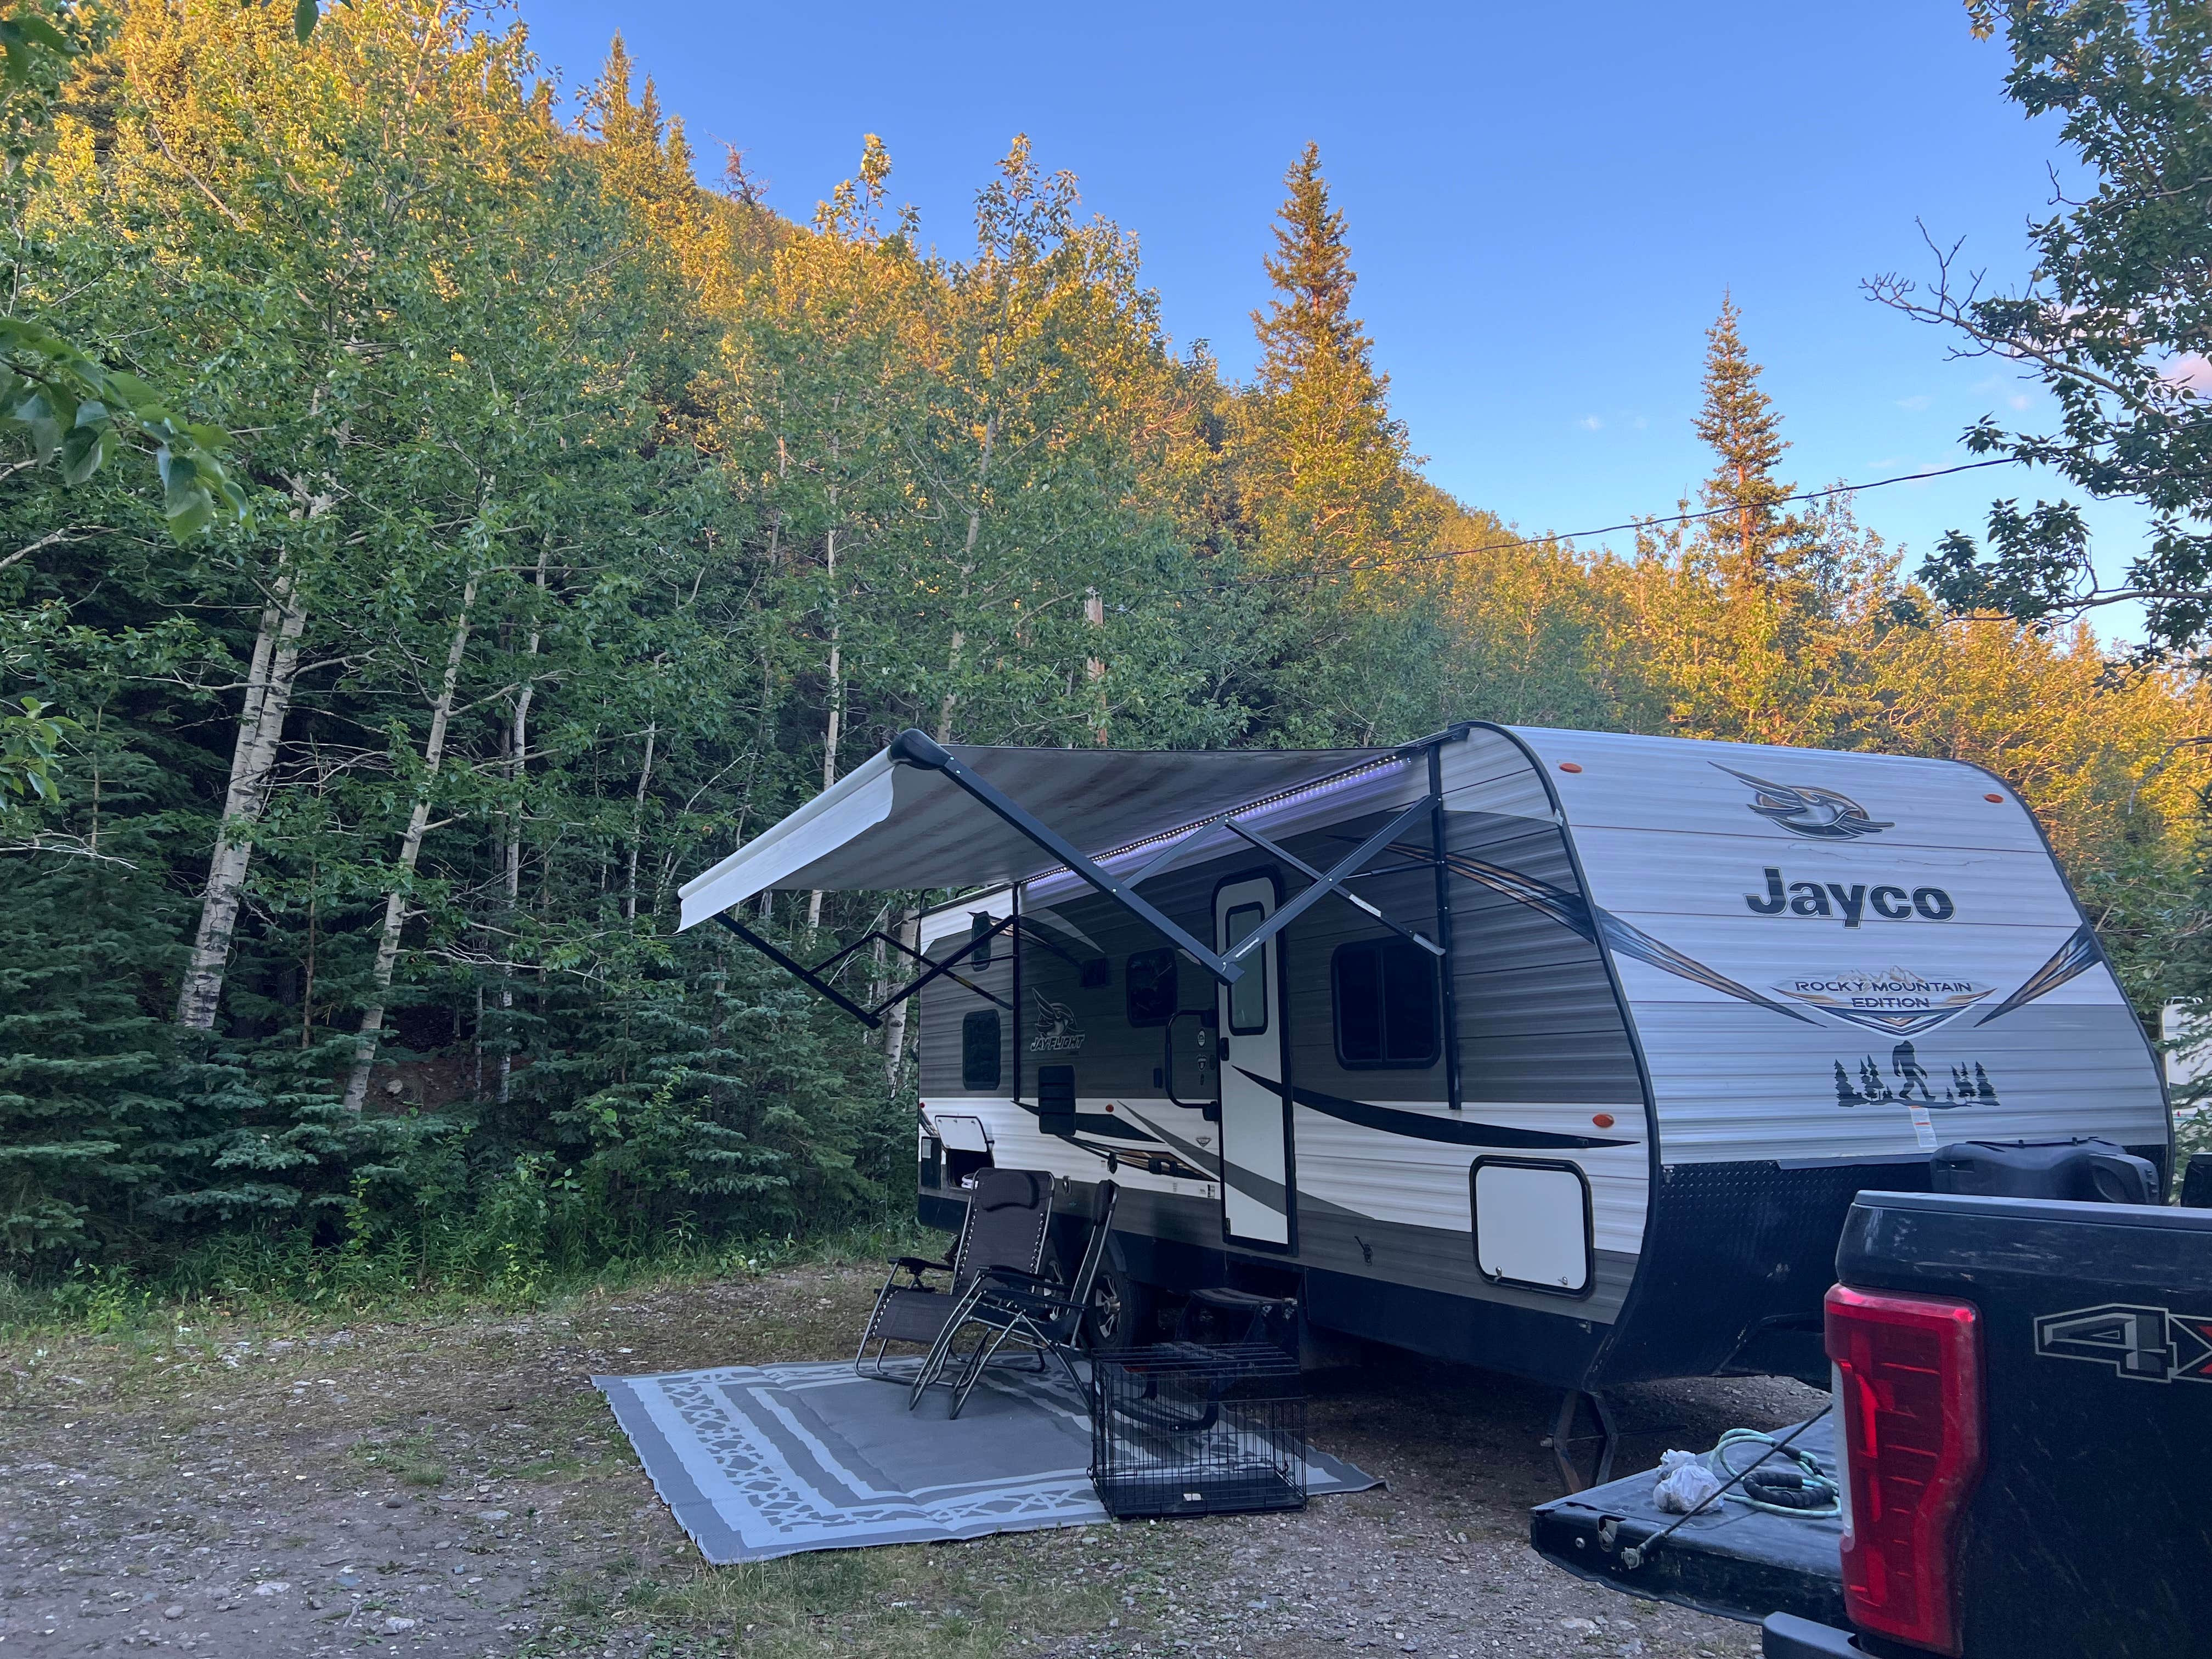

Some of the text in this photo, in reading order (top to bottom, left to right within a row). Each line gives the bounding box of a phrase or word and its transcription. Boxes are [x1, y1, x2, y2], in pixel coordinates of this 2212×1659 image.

[1743, 866, 1955, 929] Jayco
[1795, 981, 1972, 992] ROCKY MOUNTAIN
[1852, 998, 1929, 1008] EDITION
